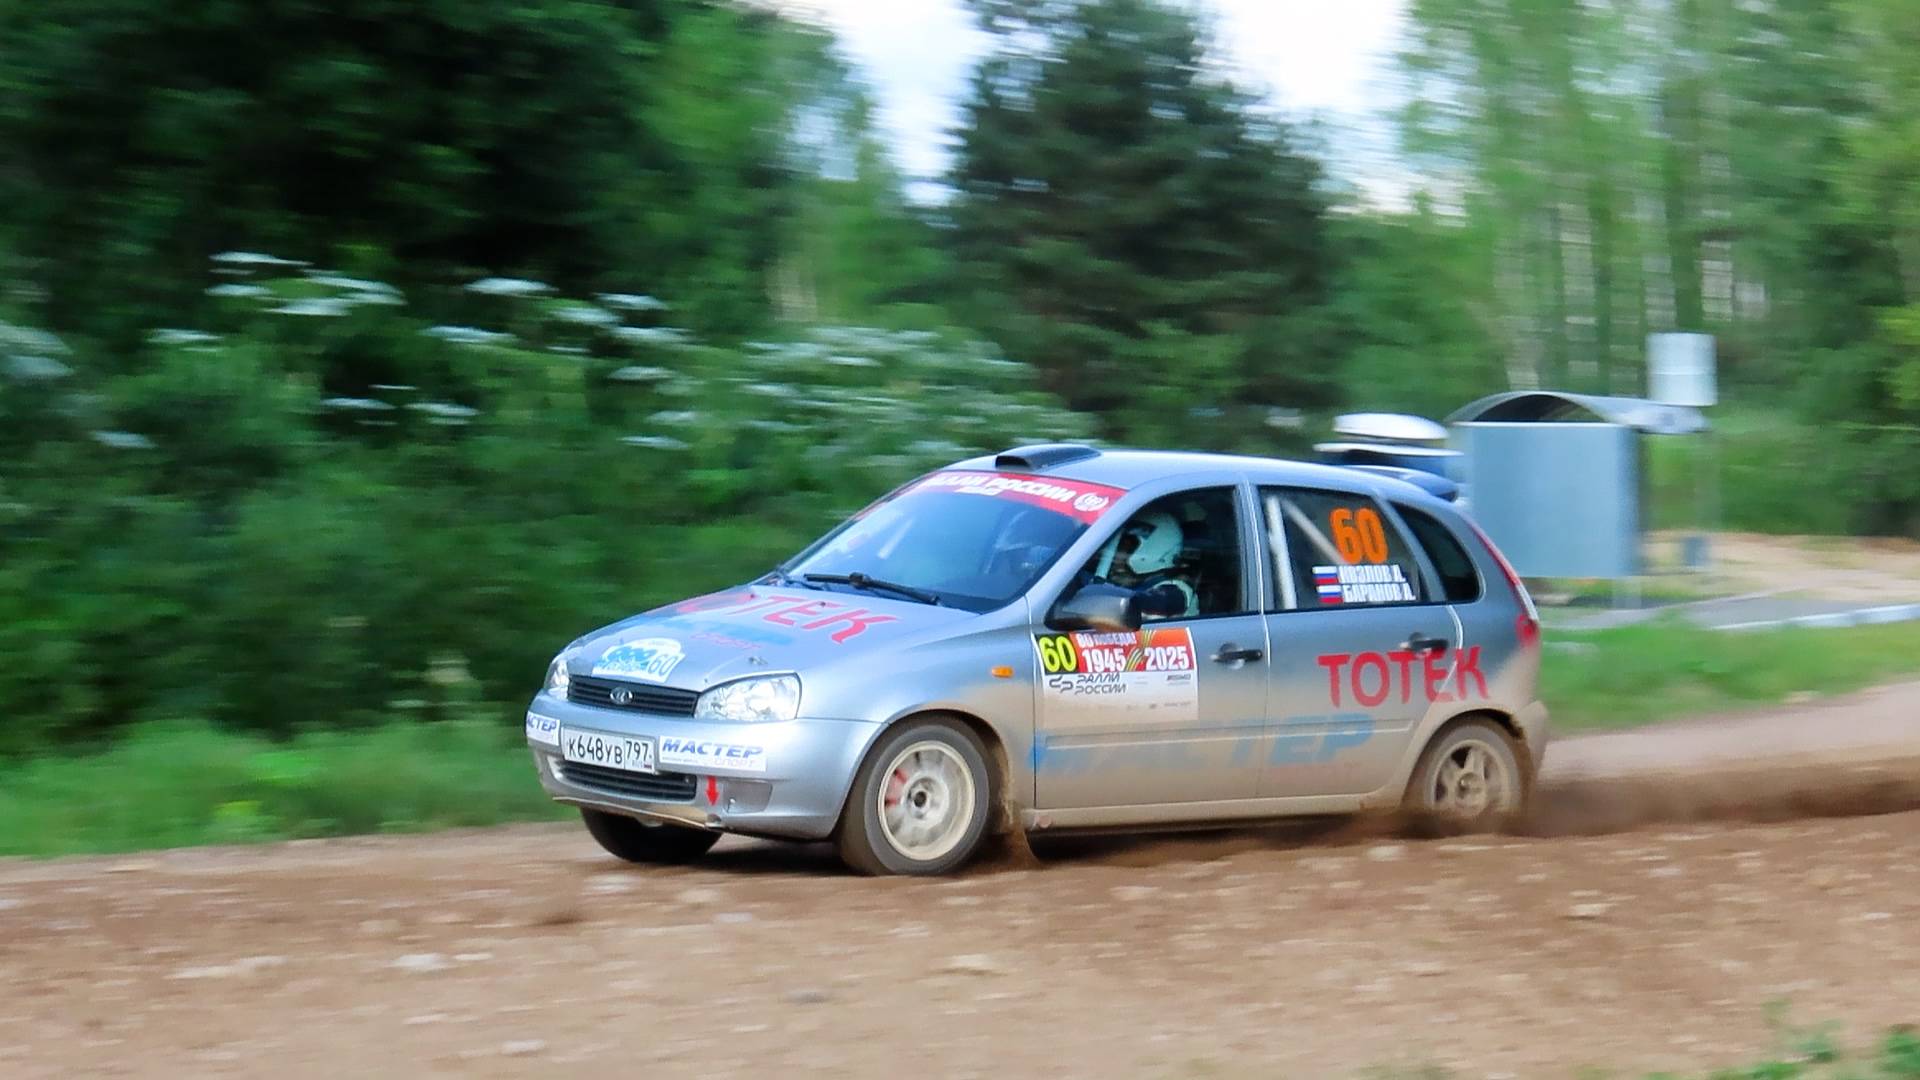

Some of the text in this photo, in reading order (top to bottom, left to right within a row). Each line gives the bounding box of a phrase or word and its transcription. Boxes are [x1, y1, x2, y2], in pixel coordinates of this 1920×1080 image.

[985, 477, 1077, 503] РОССИИ
[1330, 508, 1387, 564] 60
[1342, 583, 1403, 602] БАРАНОВ
[648, 653, 679, 676] 60
[1038, 635, 1078, 673] 60
[1082, 646, 1190, 673] 1945 2025
[1075, 684, 1128, 695] РОССИИ
[1076, 673, 1121, 683] РАЛЛИ
[1317, 646, 1489, 709] ТОТЕК
[567, 733, 650, 765] К648УВ 797
[662, 737, 764, 759] МАСТЕР
